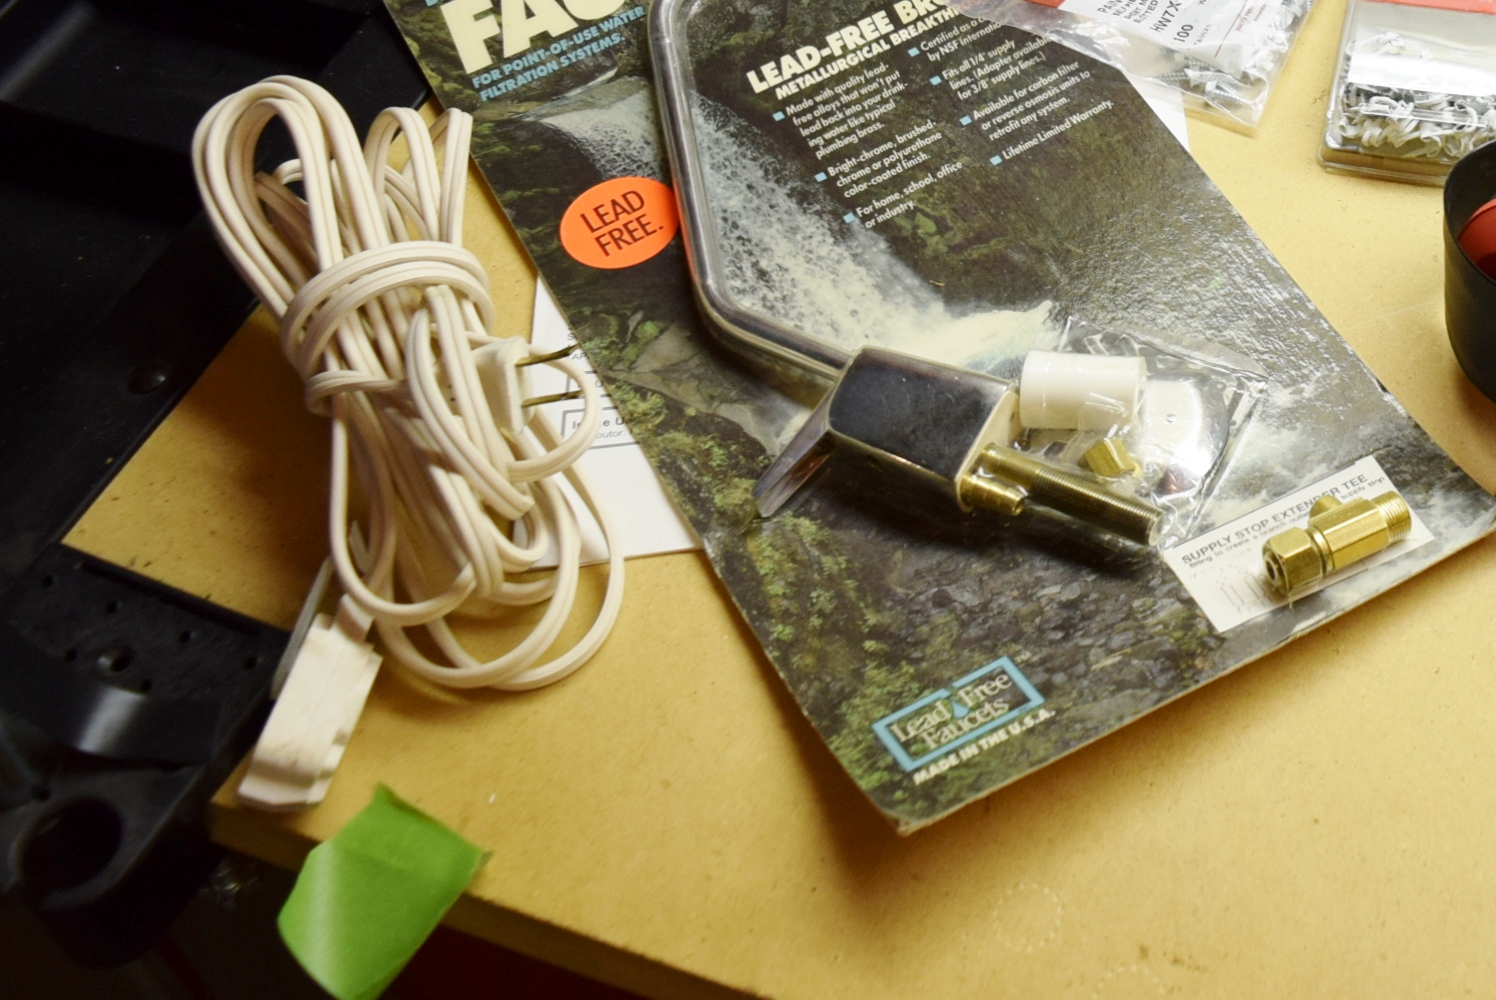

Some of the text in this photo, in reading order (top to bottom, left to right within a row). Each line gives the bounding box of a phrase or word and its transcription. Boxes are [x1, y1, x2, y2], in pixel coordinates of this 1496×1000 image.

[471, 6, 647, 89] FOR POINT-OF-USE WATER
[746, 9, 895, 94] LEAD-FREE
[920, 23, 972, 51] Certified as
[926, 41, 960, 64] by NSF
[1173, 24, 1194, 43] 100
[479, 32, 626, 101] FILTRATION SYSTEMS.
[775, 42, 890, 100] METALLURGICAL
[942, 39, 1016, 81] Fits all supply
[785, 75, 865, 116] Made with quality
[792, 70, 901, 126] free alloys that put
[956, 62, 1021, 102] for supply
[972, 61, 1080, 121] Available for carbon filter
[991, 76, 1081, 125] reverse osmosis units
[799, 94, 882, 137] lead back into your
[821, 100, 897, 140] water like typical
[988, 112, 1038, 141] retrofit any
[815, 133, 858, 161] plumbing
[836, 131, 943, 188] chrome or polyurethane
[1001, 119, 1073, 160] Lifetime Limited
[843, 161, 904, 198] color-coated
[856, 161, 963, 218] For office
[580, 190, 645, 233] LEAD
[864, 218, 877, 229] or
[594, 213, 664, 257] FREE.
[1181, 533, 1231, 566] SUPPLY
[1235, 518, 1270, 541] STOP
[1341, 473, 1370, 491] TEE
[889, 674, 1013, 743] Lead Free
[921, 698, 1009, 750] Faucets
[913, 708, 1056, 785] MADE IN THE U.S.A.
